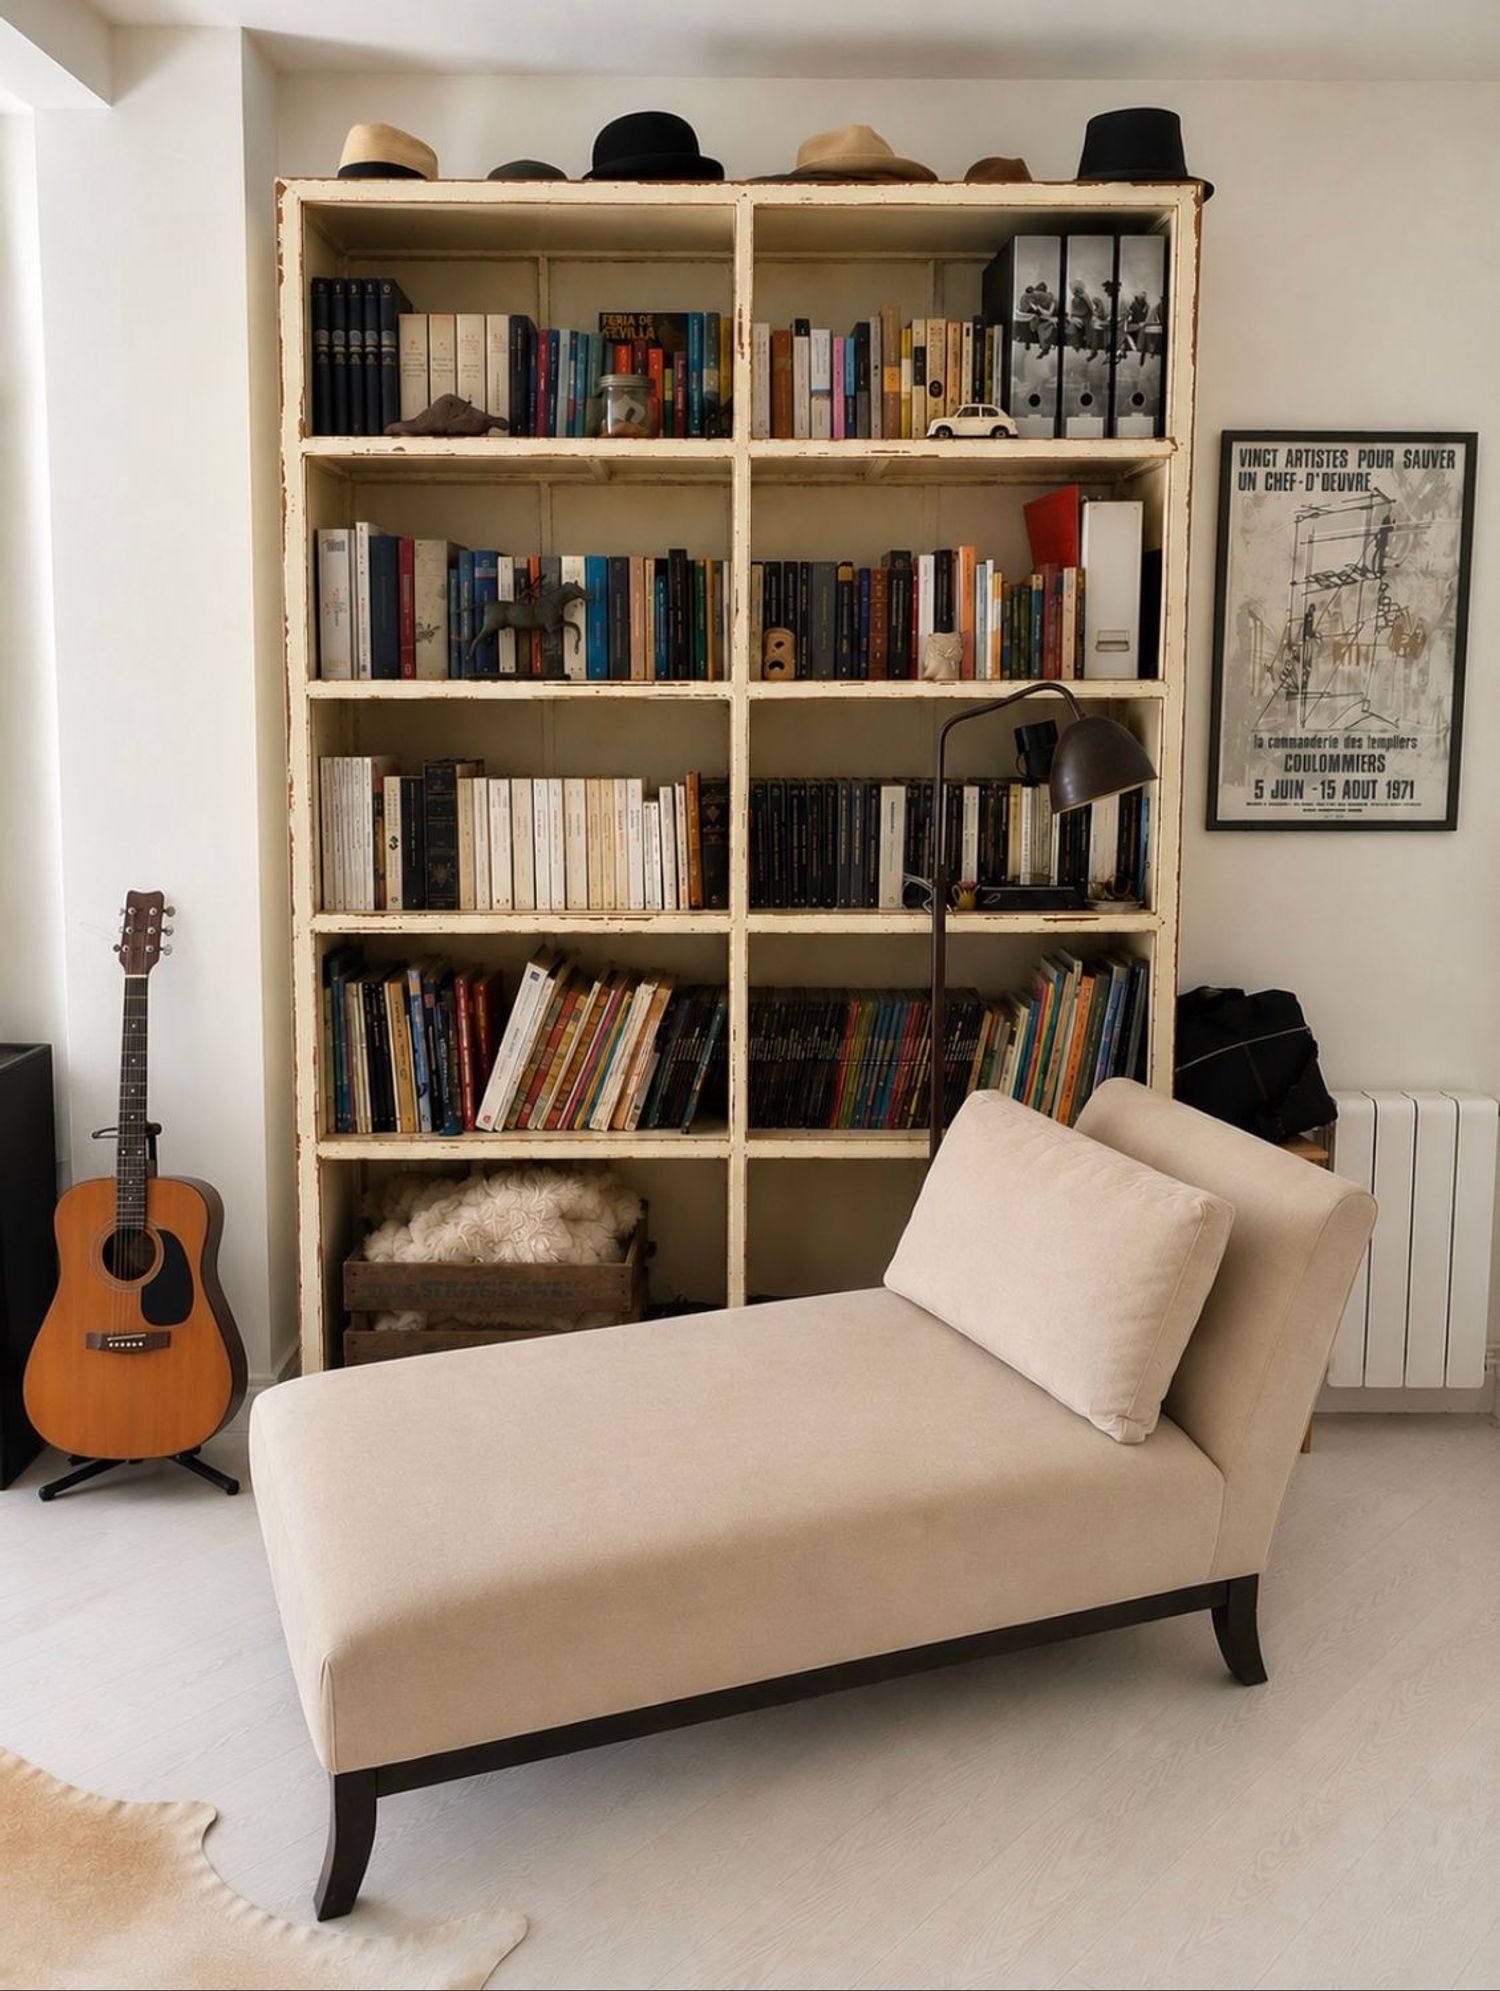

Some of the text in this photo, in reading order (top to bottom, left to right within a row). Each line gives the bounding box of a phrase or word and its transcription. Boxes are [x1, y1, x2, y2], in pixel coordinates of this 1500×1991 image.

[1285, 448, 1349, 468] ARTISTES
[1358, 449, 1394, 468] POUR
[1403, 449, 1456, 469] SAUVER
[1238, 472, 1258, 491] UN
[1254, 735, 1418, 751] la commanderie des templiers
[1284, 754, 1386, 773] COULOMMIERS
[1254, 779, 1264, 799] 5
[1271, 779, 1304, 799] JUIN
[1342, 779, 1378, 799] AOUT
[1385, 779, 1415, 799] 1971
